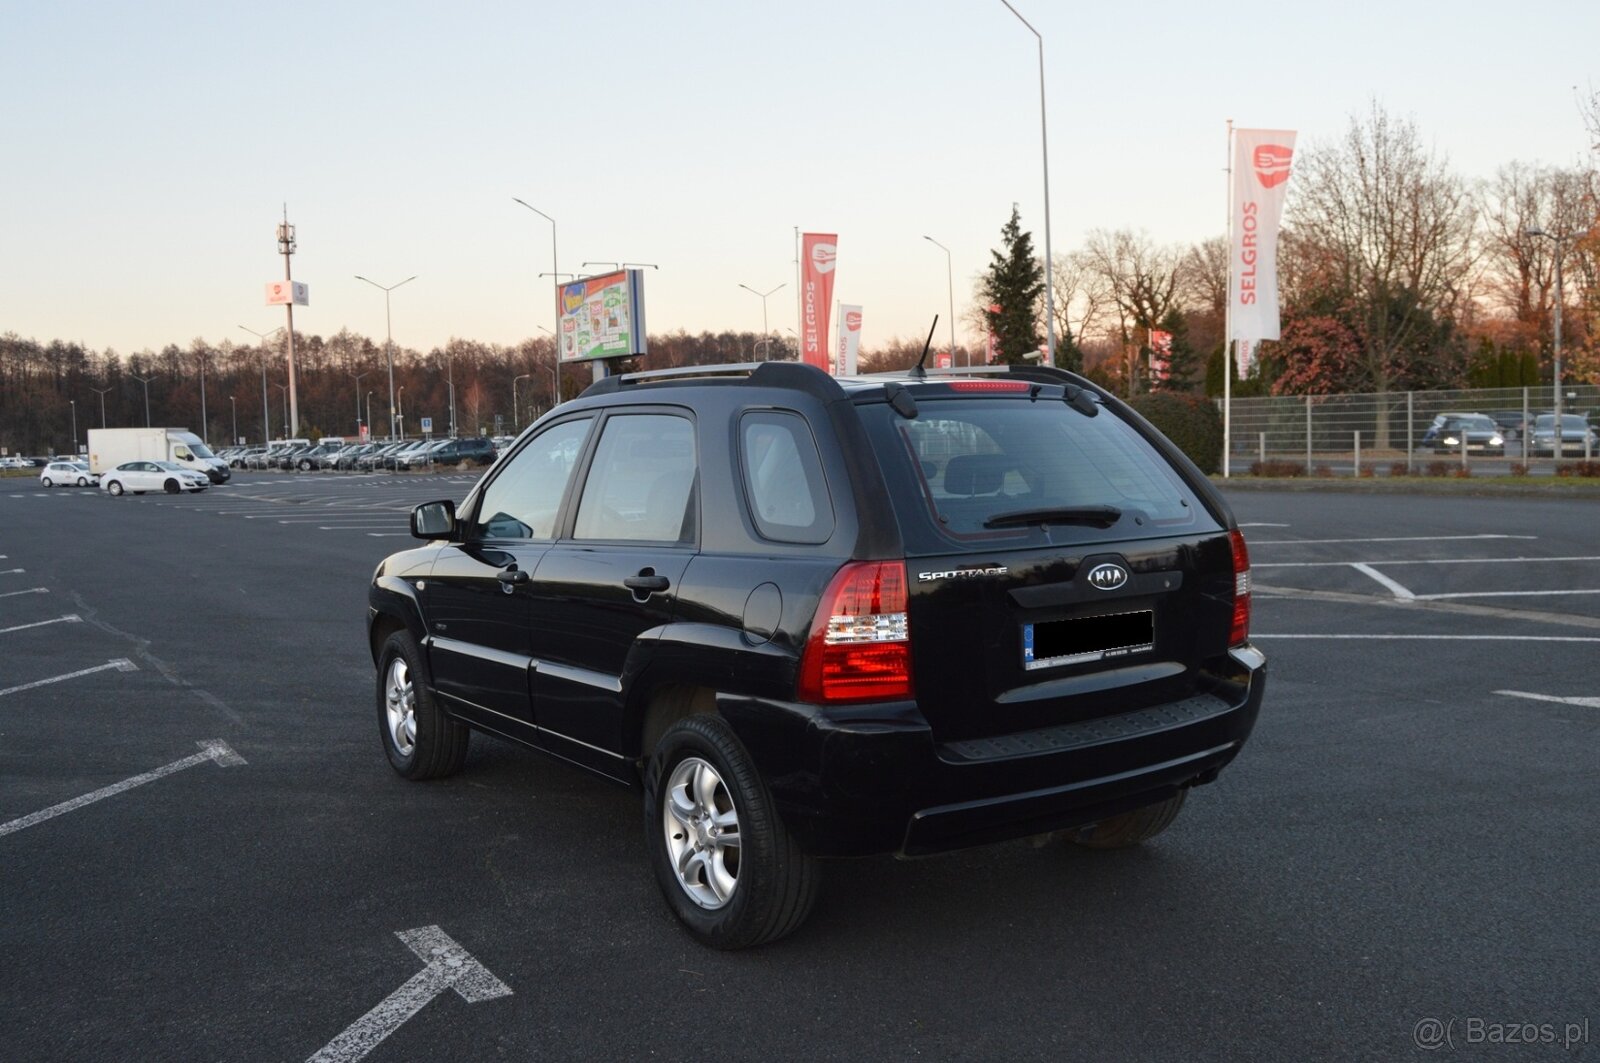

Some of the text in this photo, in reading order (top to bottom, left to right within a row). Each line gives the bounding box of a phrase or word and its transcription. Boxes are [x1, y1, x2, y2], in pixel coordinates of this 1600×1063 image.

[1241, 202, 1257, 304] SELGROS
[806, 281, 818, 352] SELGROS
[919, 567, 1007, 581] SPORTAGE
[1094, 569, 1122, 584] KIA
[1024, 648, 1034, 657] PL
